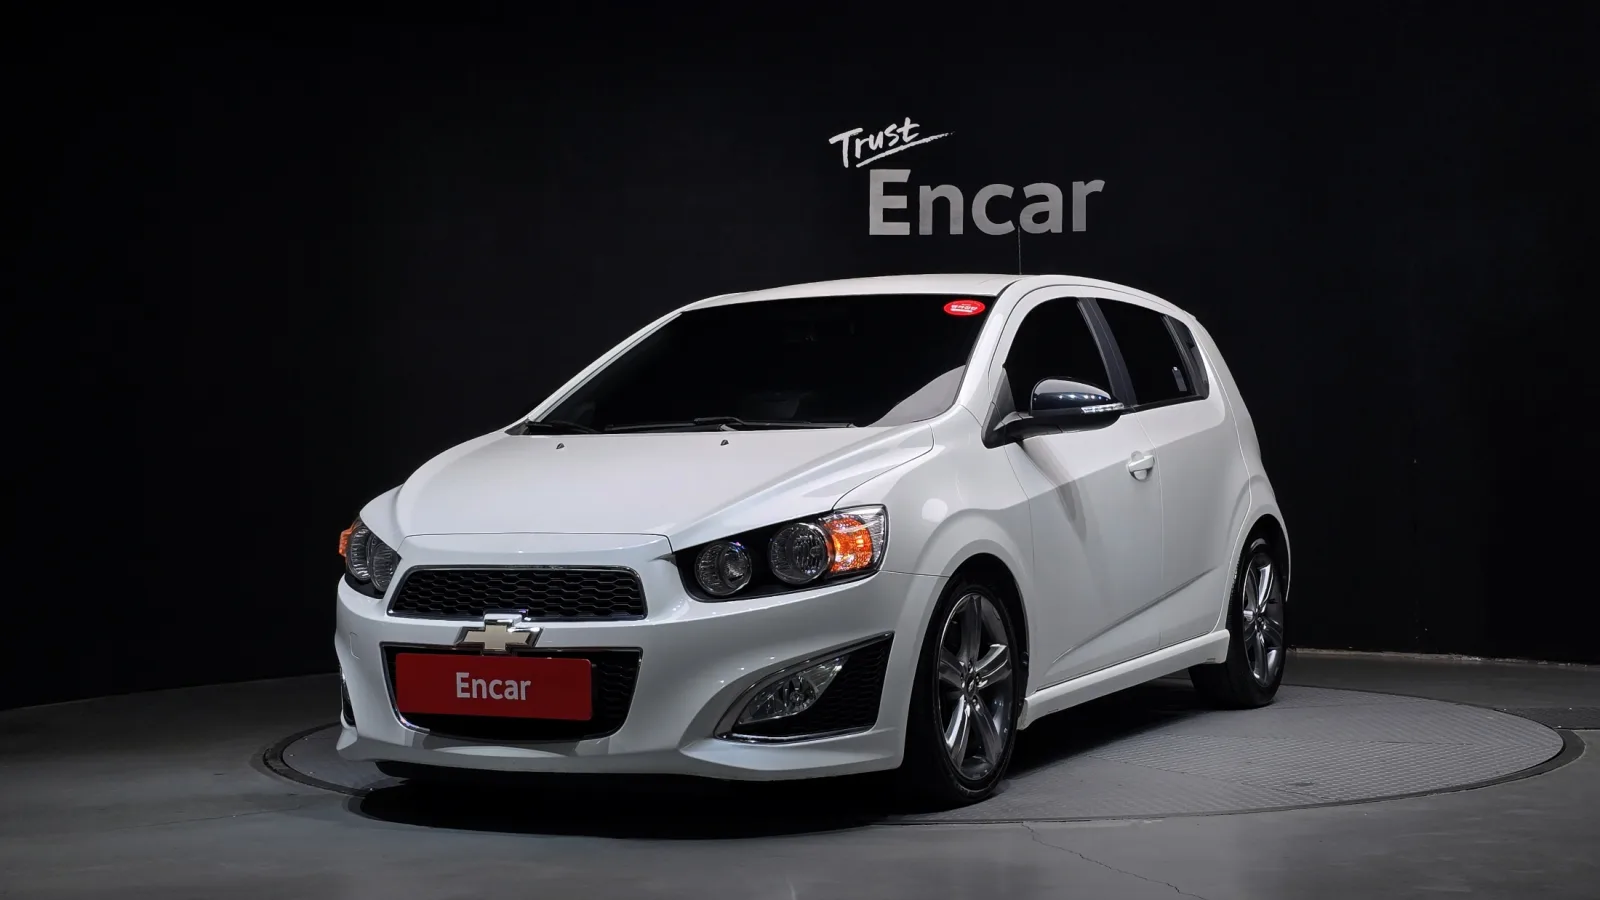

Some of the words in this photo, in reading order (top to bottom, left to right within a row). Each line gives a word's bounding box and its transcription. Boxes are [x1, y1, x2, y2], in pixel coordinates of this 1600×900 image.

[828, 116, 922, 168] Trust
[869, 168, 1106, 236] Encar
[455, 671, 532, 701] Encar
